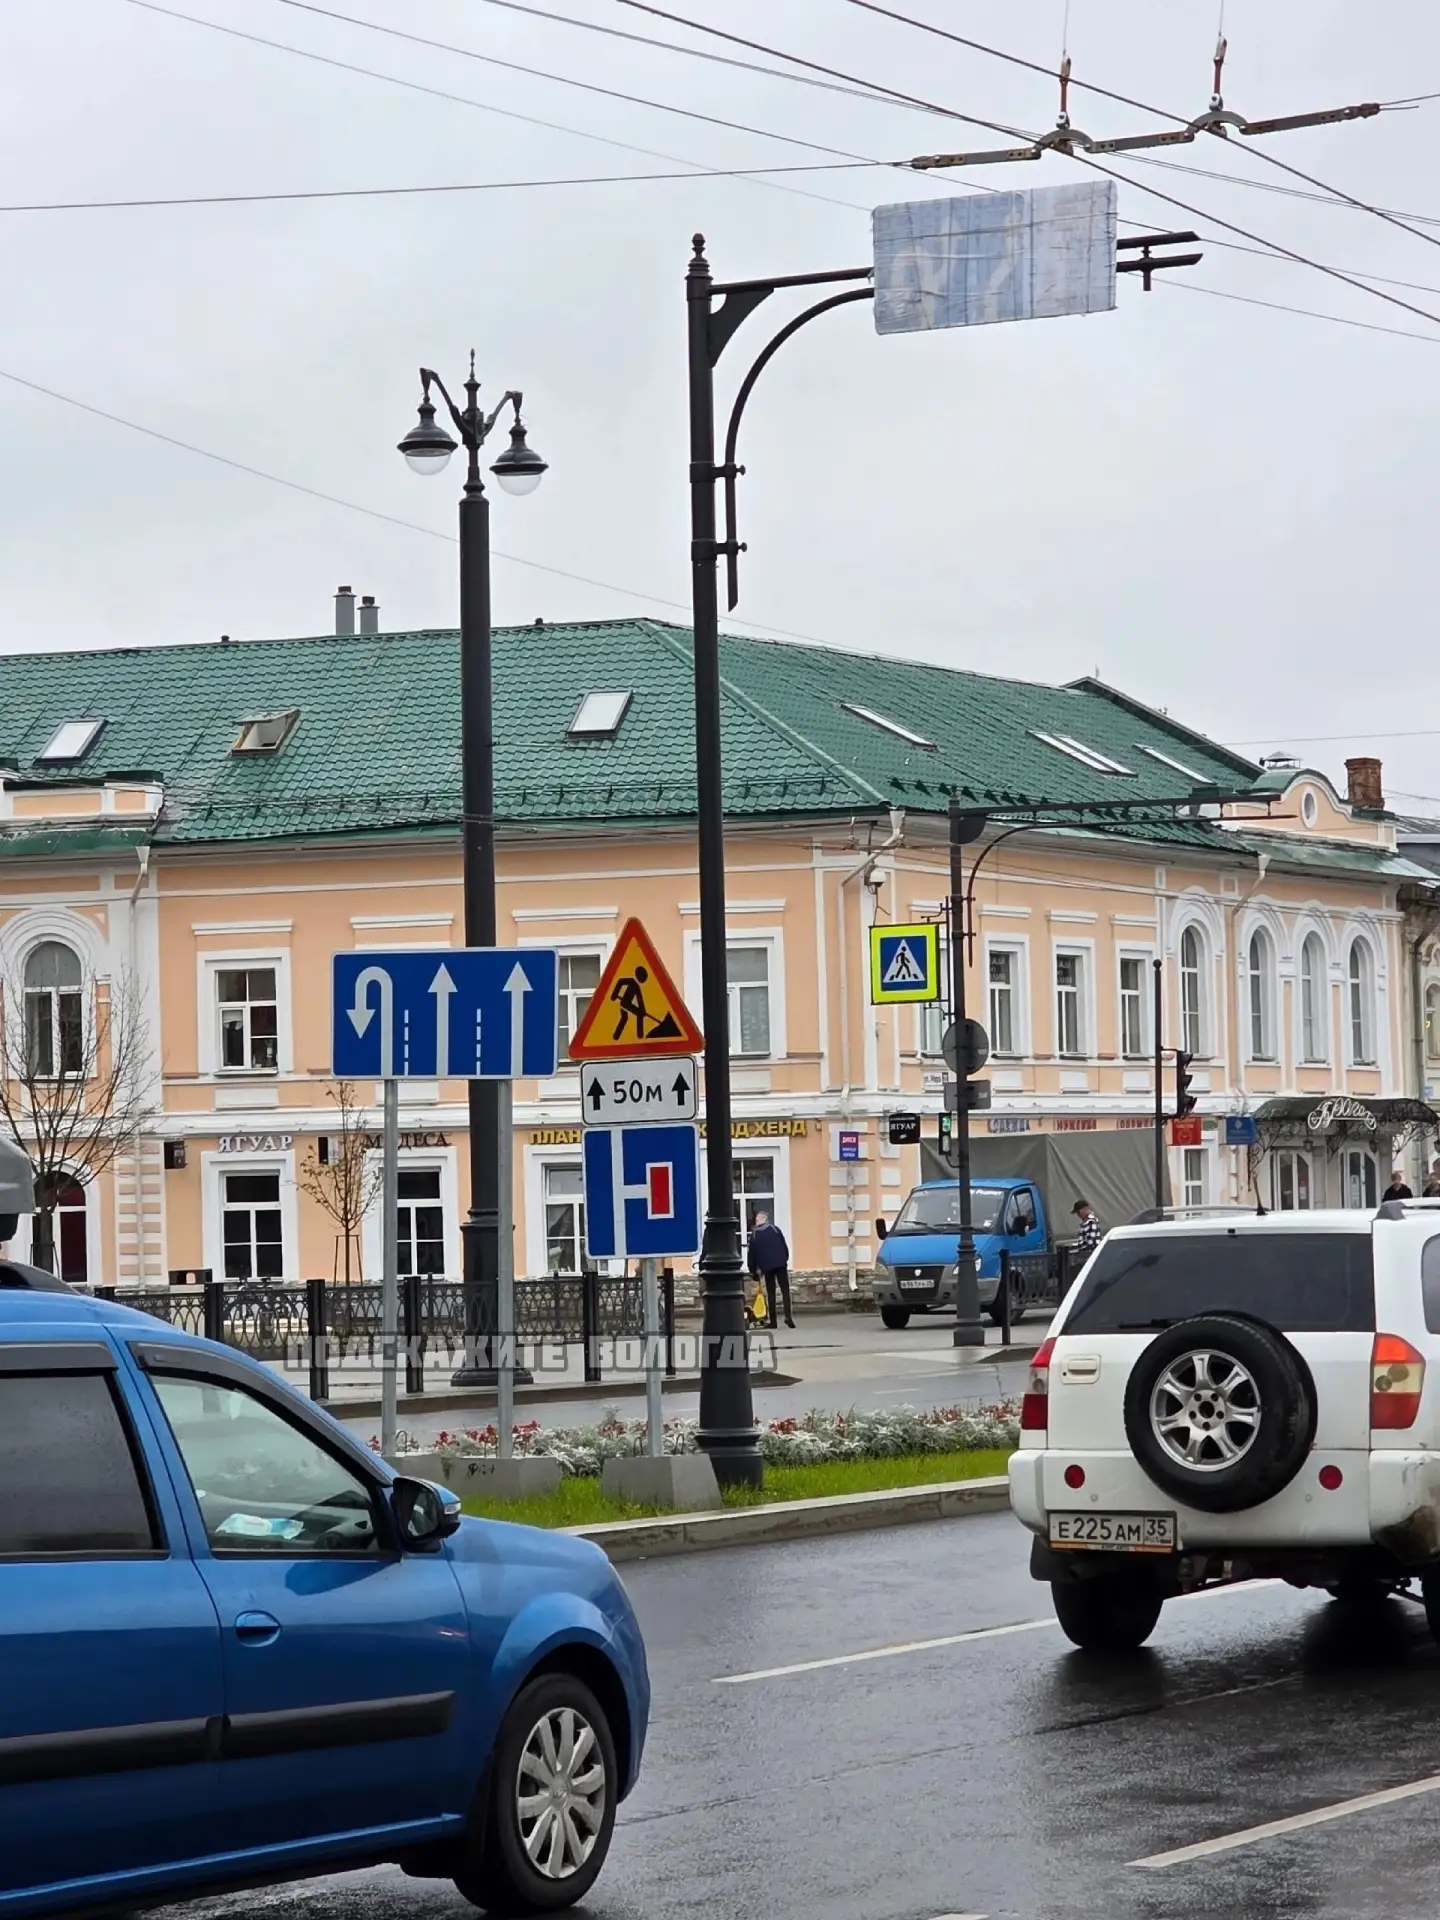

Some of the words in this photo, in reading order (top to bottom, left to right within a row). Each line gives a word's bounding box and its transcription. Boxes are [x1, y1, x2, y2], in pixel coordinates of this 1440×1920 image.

[753, 1119, 807, 1138] ХЕНД
[890, 1122, 917, 1131] ЯГУАР
[218, 1135, 293, 1153] ЯГУАР
[365, 1132, 452, 1150] МДЕСА
[1146, 1519, 1167, 1537] 35
